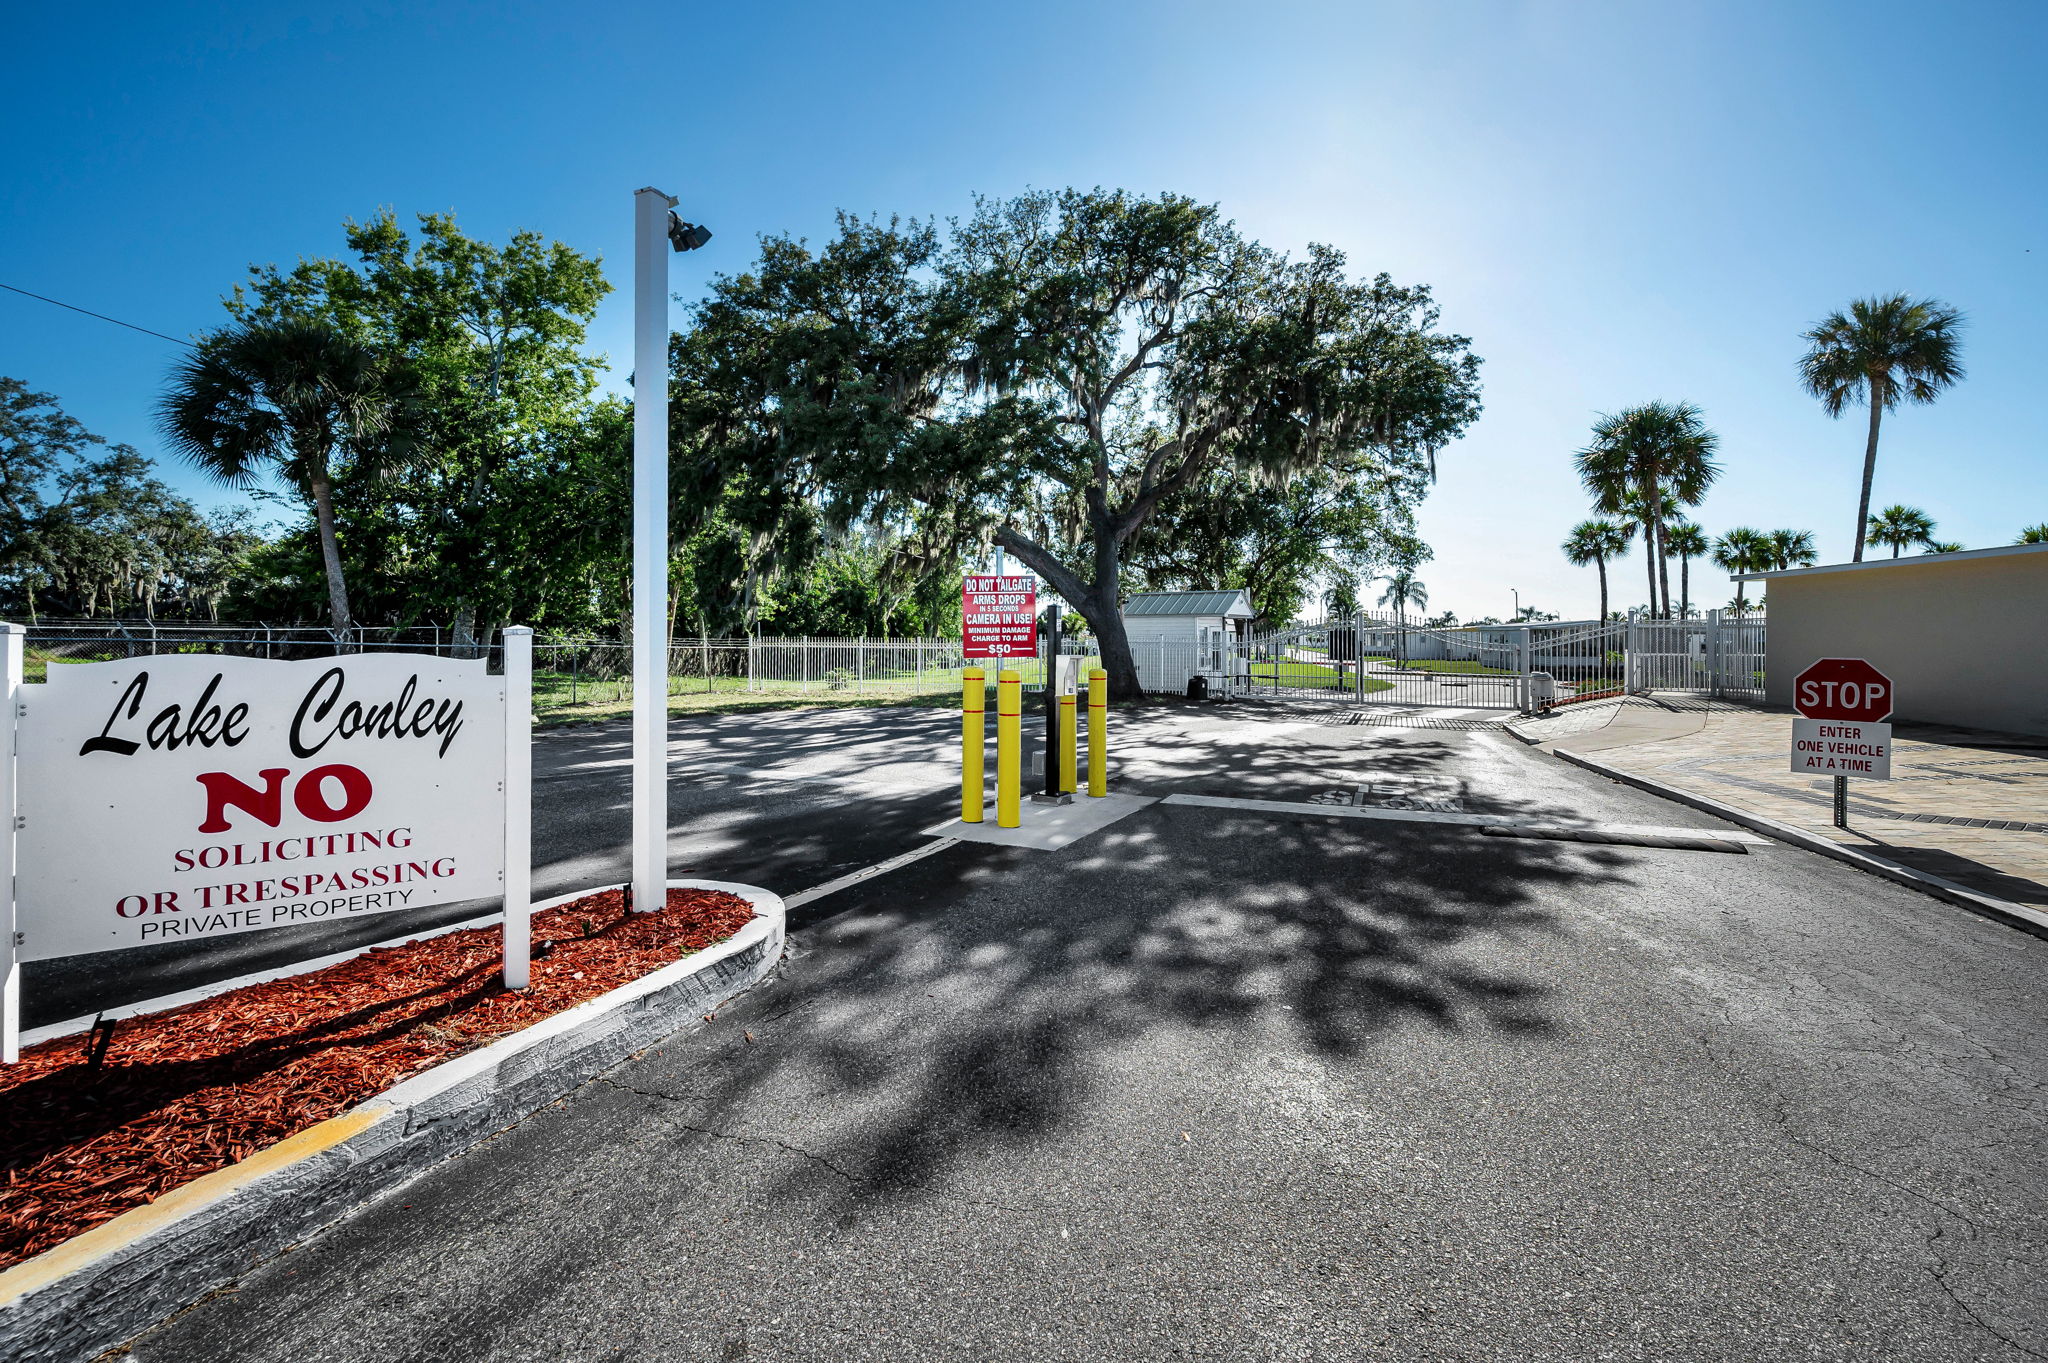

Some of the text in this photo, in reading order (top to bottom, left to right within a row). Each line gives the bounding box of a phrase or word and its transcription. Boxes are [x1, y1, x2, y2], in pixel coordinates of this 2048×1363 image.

[966, 579, 1032, 591] DO NOT TAILGATE
[973, 595, 1025, 604] ARMS DROPS
[966, 614, 1032, 624] CAMERA IN USE!
[988, 643, 1011, 654] $50
[1801, 681, 1885, 709] STOP
[79, 667, 463, 759] Lake Conley
[1820, 726, 1860, 739] ENTER
[1798, 740, 1883, 757] ONE VEHICLE
[1807, 757, 1872, 772] AT A TIME
[196, 764, 373, 834] NO
[174, 827, 413, 872] SOLICITING
[116, 857, 456, 919] OR TRESPASSING
[141, 889, 414, 940] PRIVATE PROPERTY
